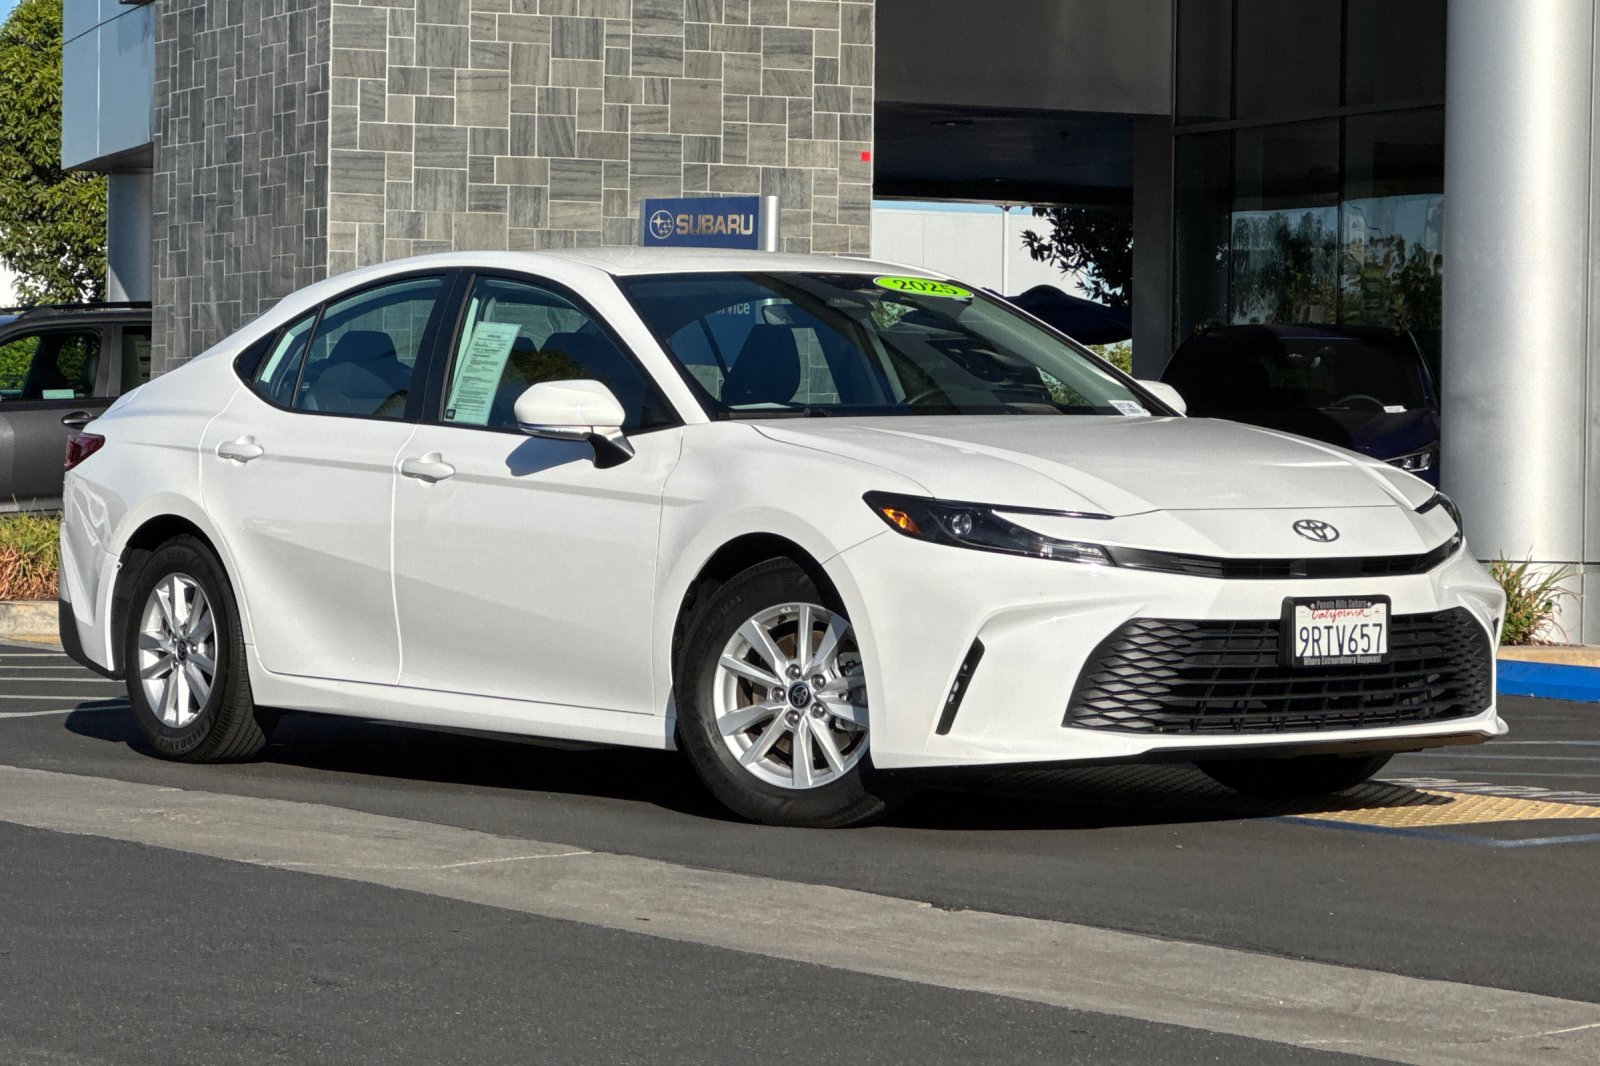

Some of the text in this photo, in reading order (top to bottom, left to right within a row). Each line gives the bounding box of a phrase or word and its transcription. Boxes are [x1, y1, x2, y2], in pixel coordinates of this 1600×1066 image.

[676, 214, 754, 235] SUBARU
[893, 279, 959, 295] 2025
[1311, 608, 1369, 624] California
[1299, 623, 1383, 657] 9RTV657
